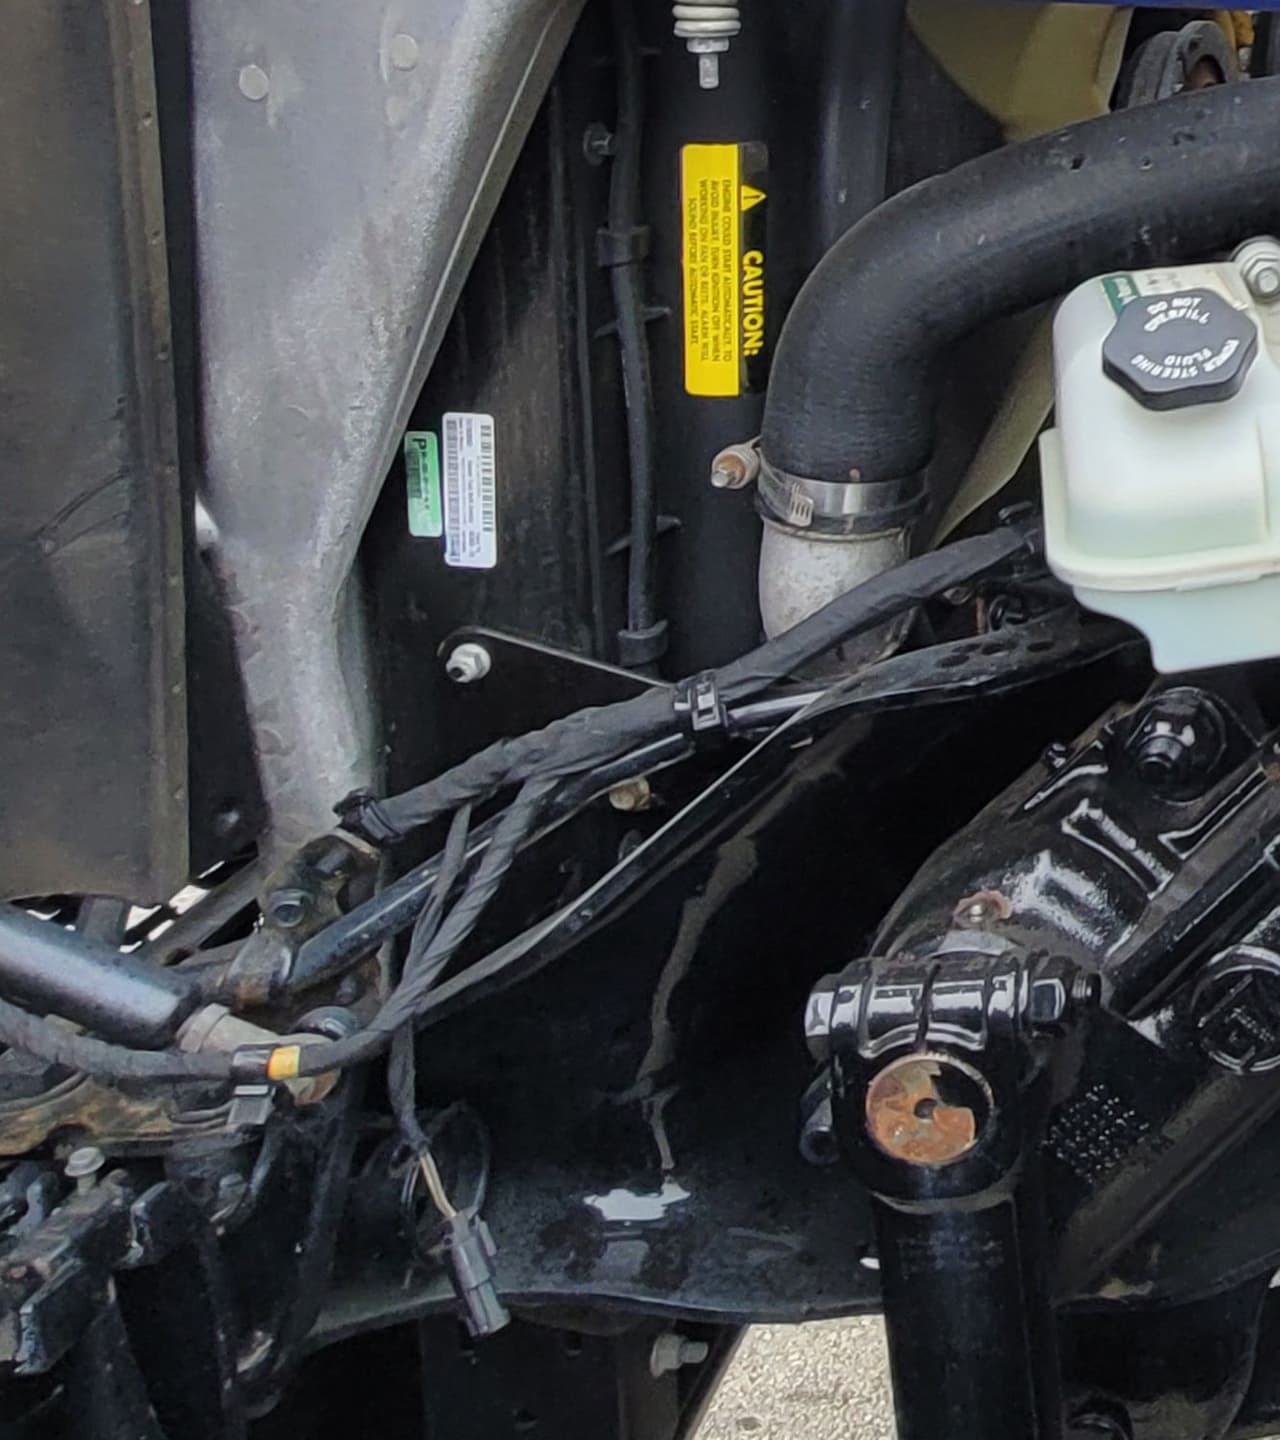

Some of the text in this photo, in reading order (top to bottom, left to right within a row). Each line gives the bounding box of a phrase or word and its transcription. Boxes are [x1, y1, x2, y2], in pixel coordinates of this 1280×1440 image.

[700, 179, 709, 225] WORKING
[711, 180, 721, 208] AVOID
[700, 227, 709, 243] ON
[700, 245, 709, 263] FAN
[711, 247, 721, 270] TURN
[722, 249, 732, 273] START
[711, 272, 721, 313] IGNITION
[742, 250, 764, 357] CAUTION:
[1146, 296, 1203, 315] DO NOT
[700, 309, 709, 339] ALARM
[1130, 354, 1199, 380] STEERING
[1164, 347, 1213, 366] FLUID
